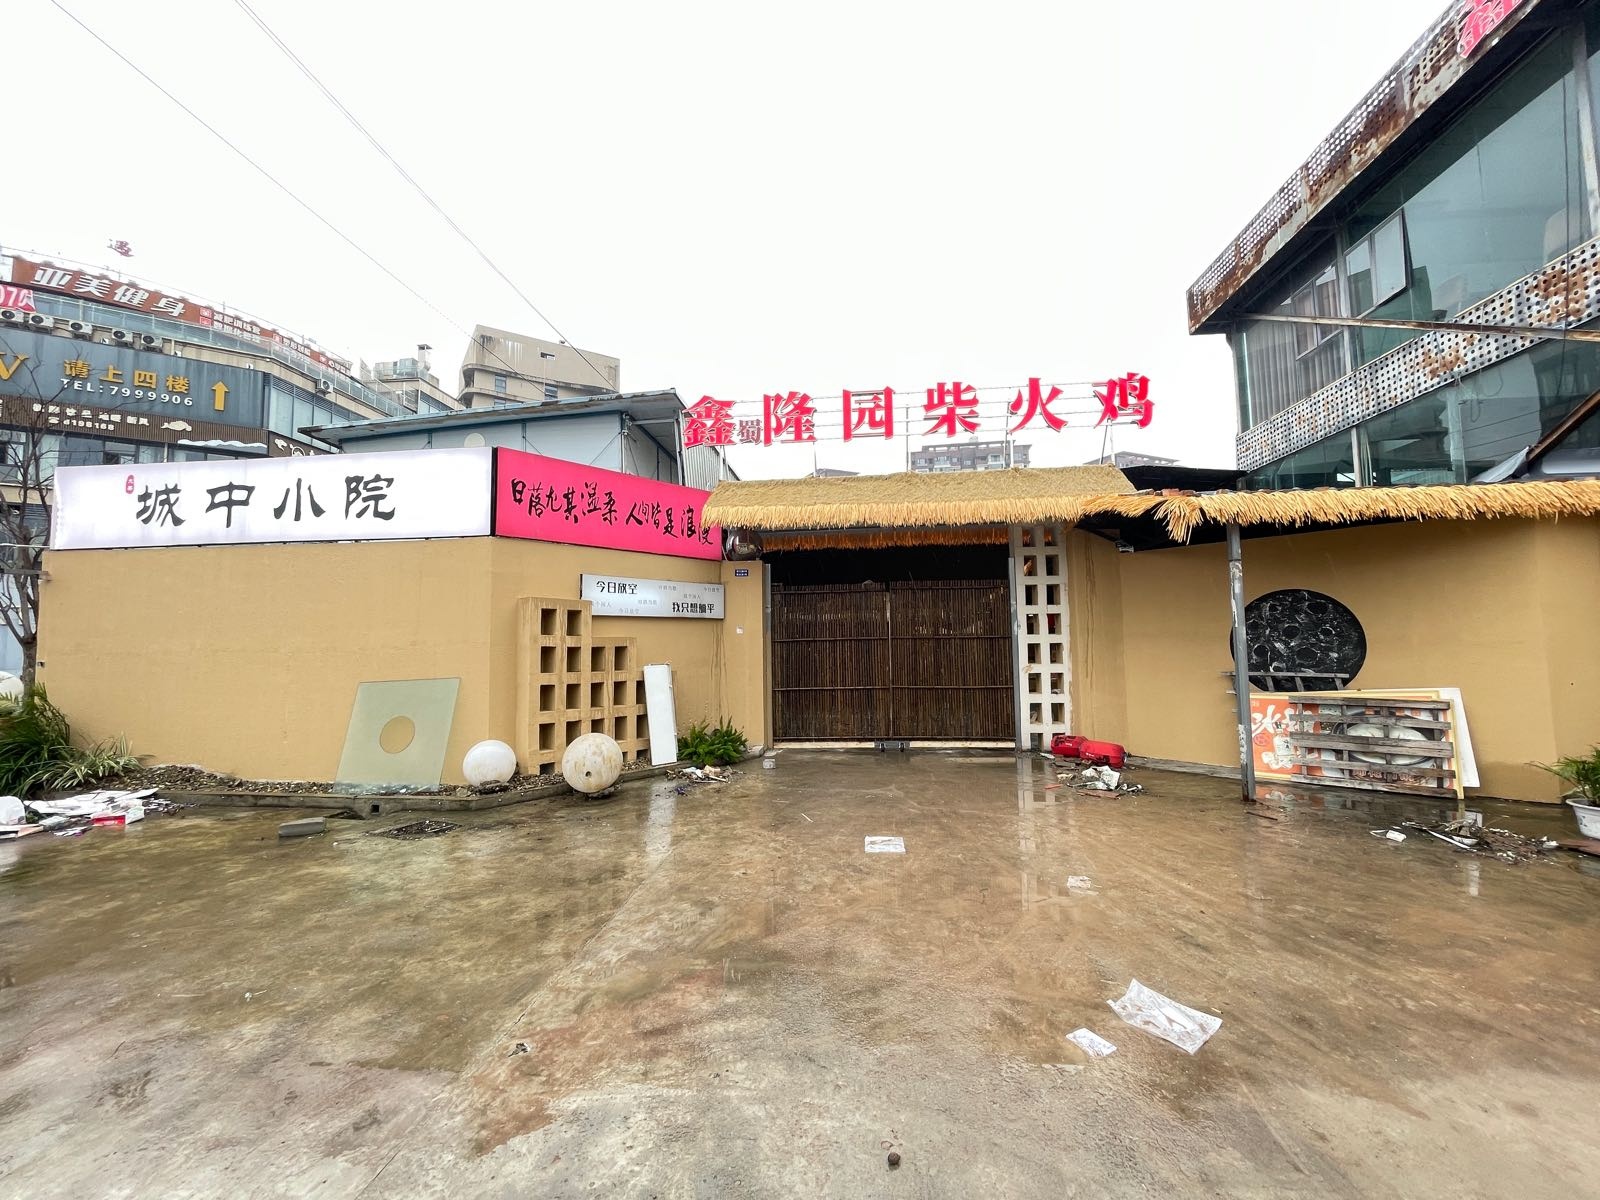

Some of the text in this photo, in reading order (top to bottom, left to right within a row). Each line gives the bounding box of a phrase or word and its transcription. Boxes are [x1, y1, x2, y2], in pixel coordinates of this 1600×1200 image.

[30, 266, 186, 317] 亚美健身
[60, 378, 194, 406] TEL:7999906
[63, 359, 190, 394] 请上四楼
[136, 473, 396, 529] 城中小院
[510, 477, 618, 526] 日落尤其温柔
[596, 580, 638, 595] 今日放空
